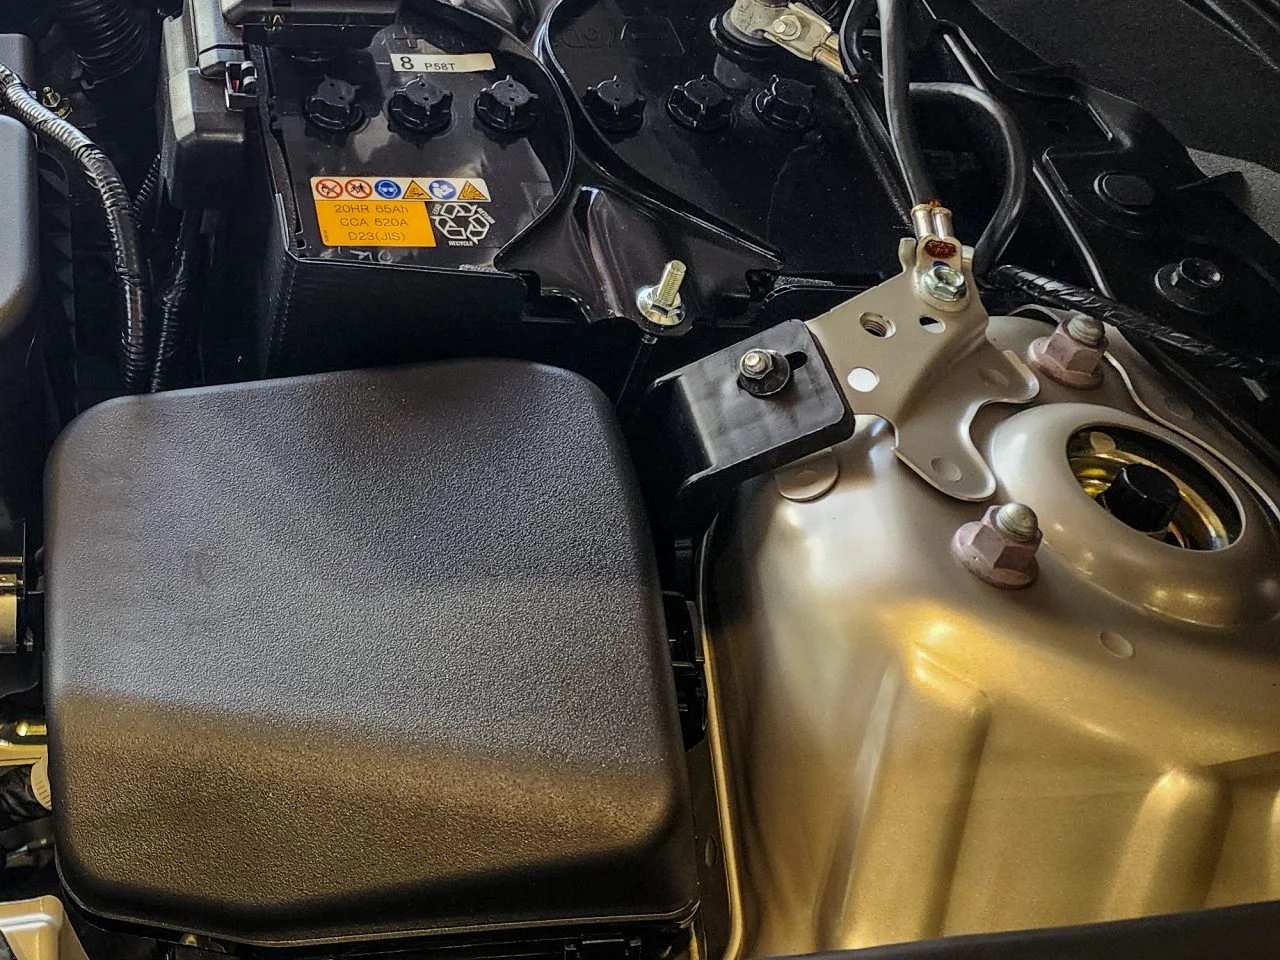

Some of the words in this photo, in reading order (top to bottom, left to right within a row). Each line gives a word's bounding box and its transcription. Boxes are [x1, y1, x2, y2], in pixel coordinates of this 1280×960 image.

[400, 56, 414, 70] 8
[424, 62, 456, 71] P58T
[334, 204, 370, 213] 20HR
[375, 204, 409, 213] 65Ah
[340, 217, 369, 227] CCA
[374, 217, 409, 227] 520A
[348, 231, 406, 242] D23(JIS)
